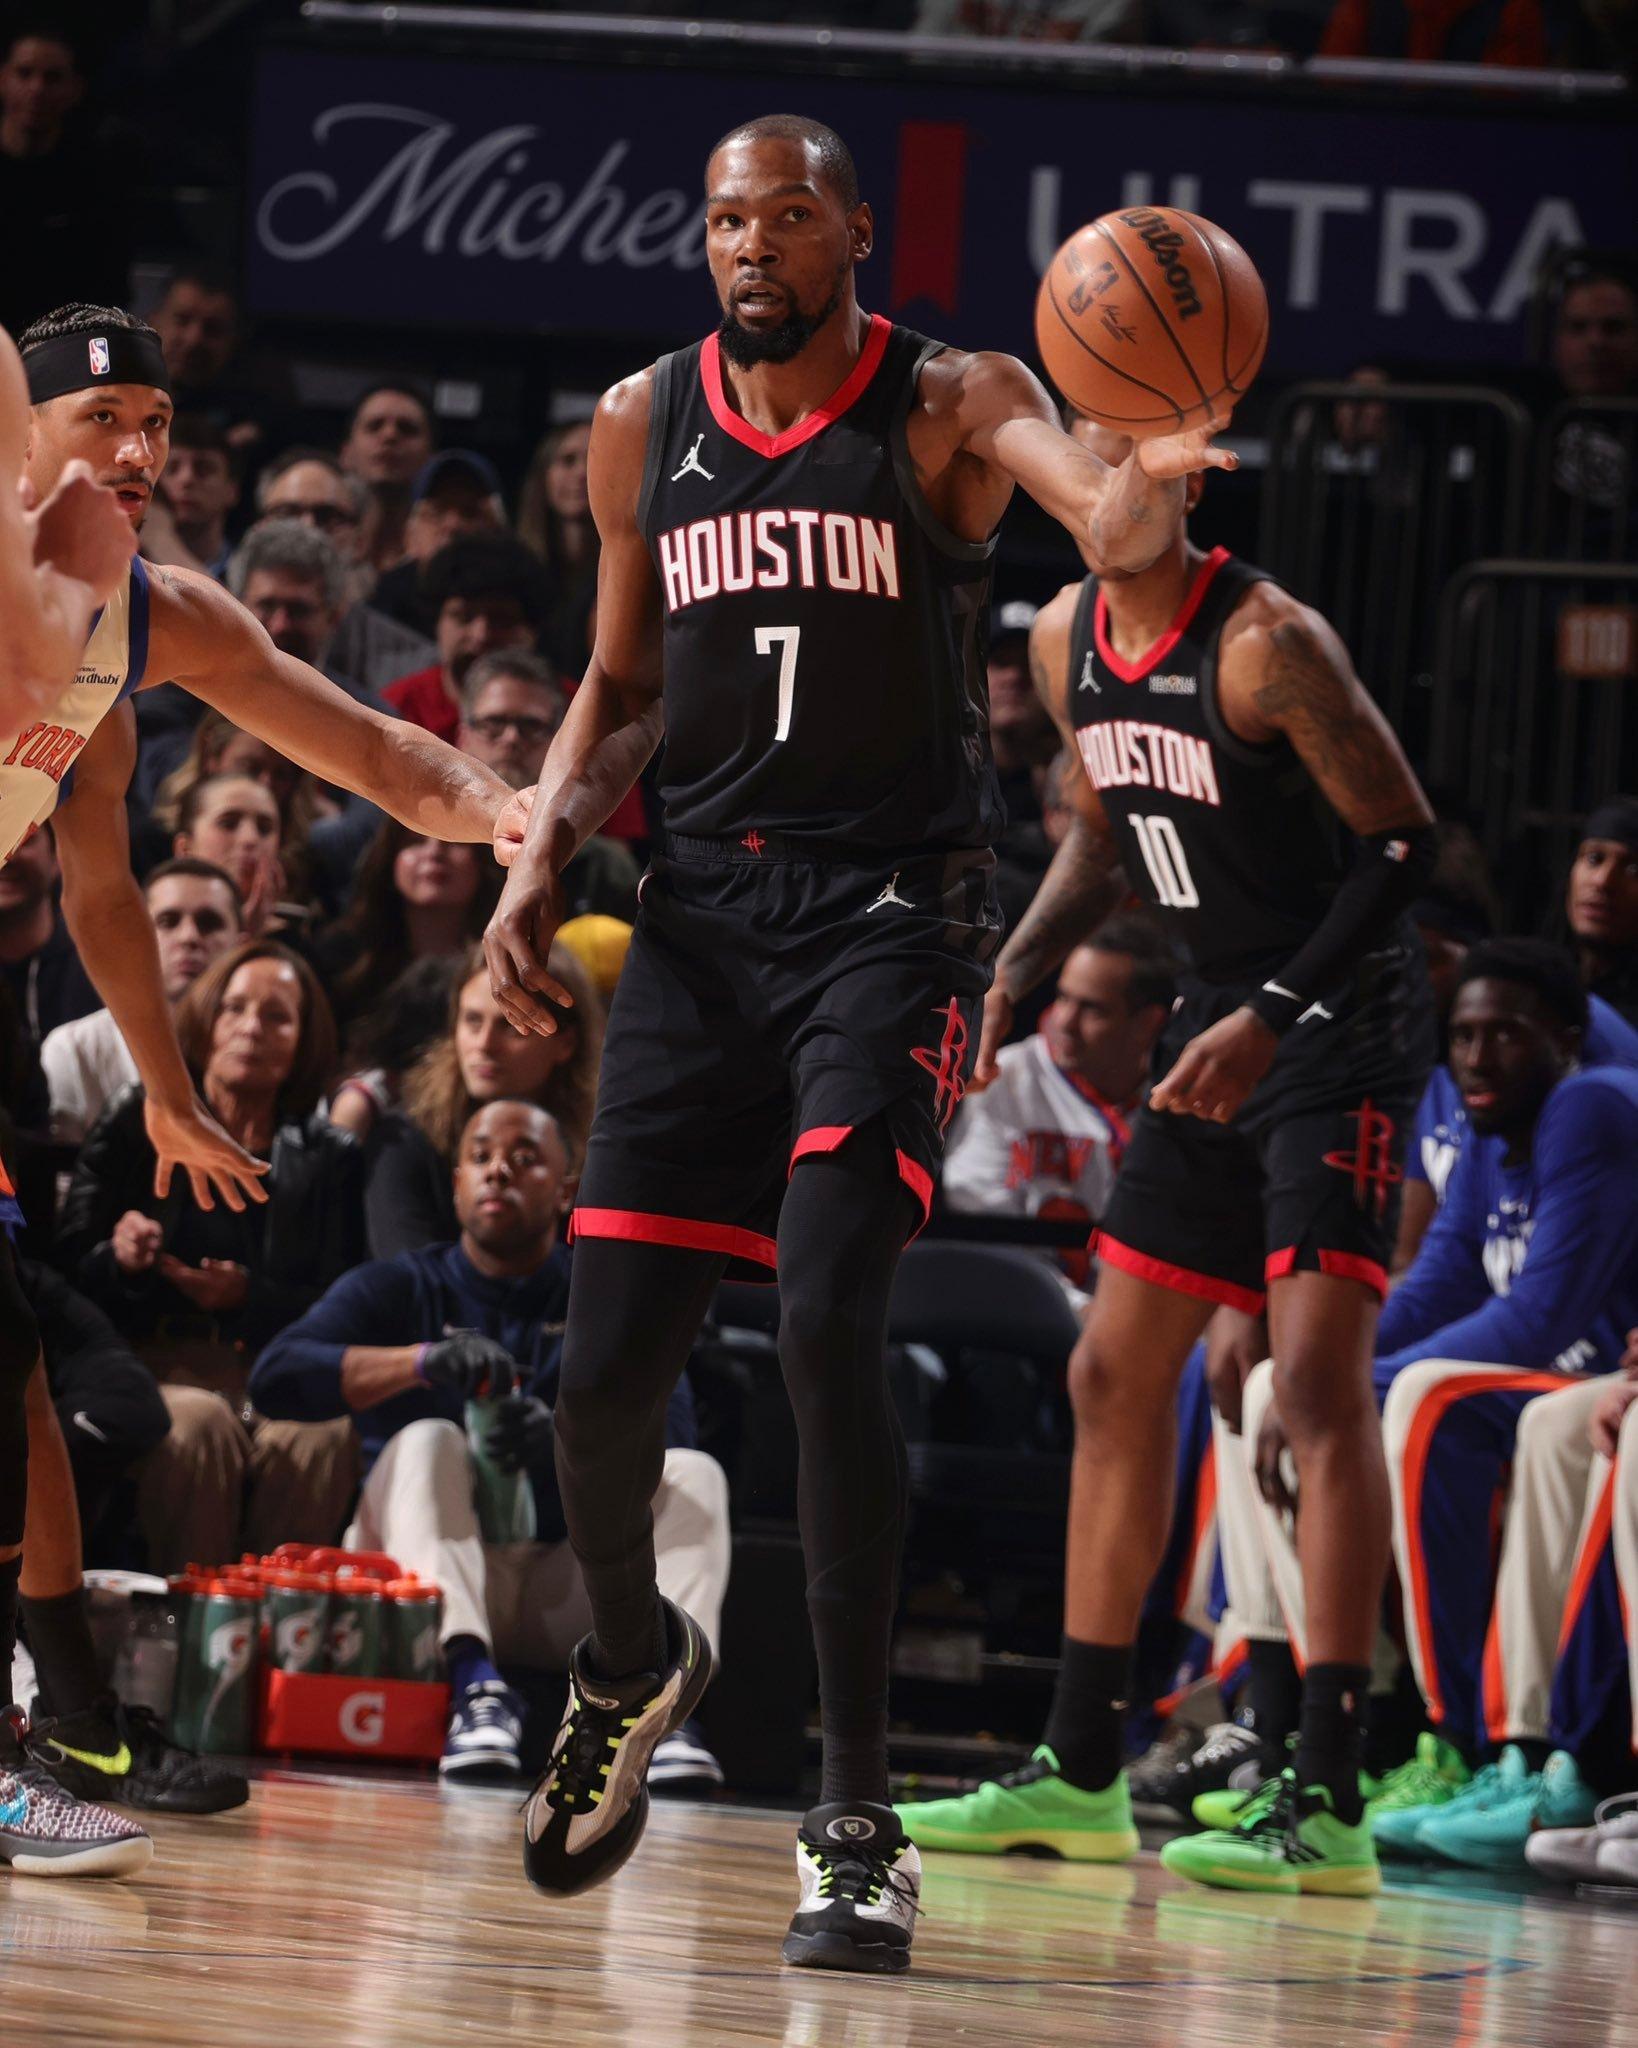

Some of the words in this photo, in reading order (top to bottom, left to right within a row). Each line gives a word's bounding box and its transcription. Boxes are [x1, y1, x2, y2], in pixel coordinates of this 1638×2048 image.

[1119, 207, 1202, 321] Wilson
[657, 508, 901, 614] HOUSTON
[86, 673, 120, 685] dhabi
[754, 626, 800, 742] 7
[3, 722, 86, 783] YORK
[1077, 720, 1220, 807] HOUSTON
[1127, 813, 1200, 908] 10
[338, 1691, 385, 1746] G
